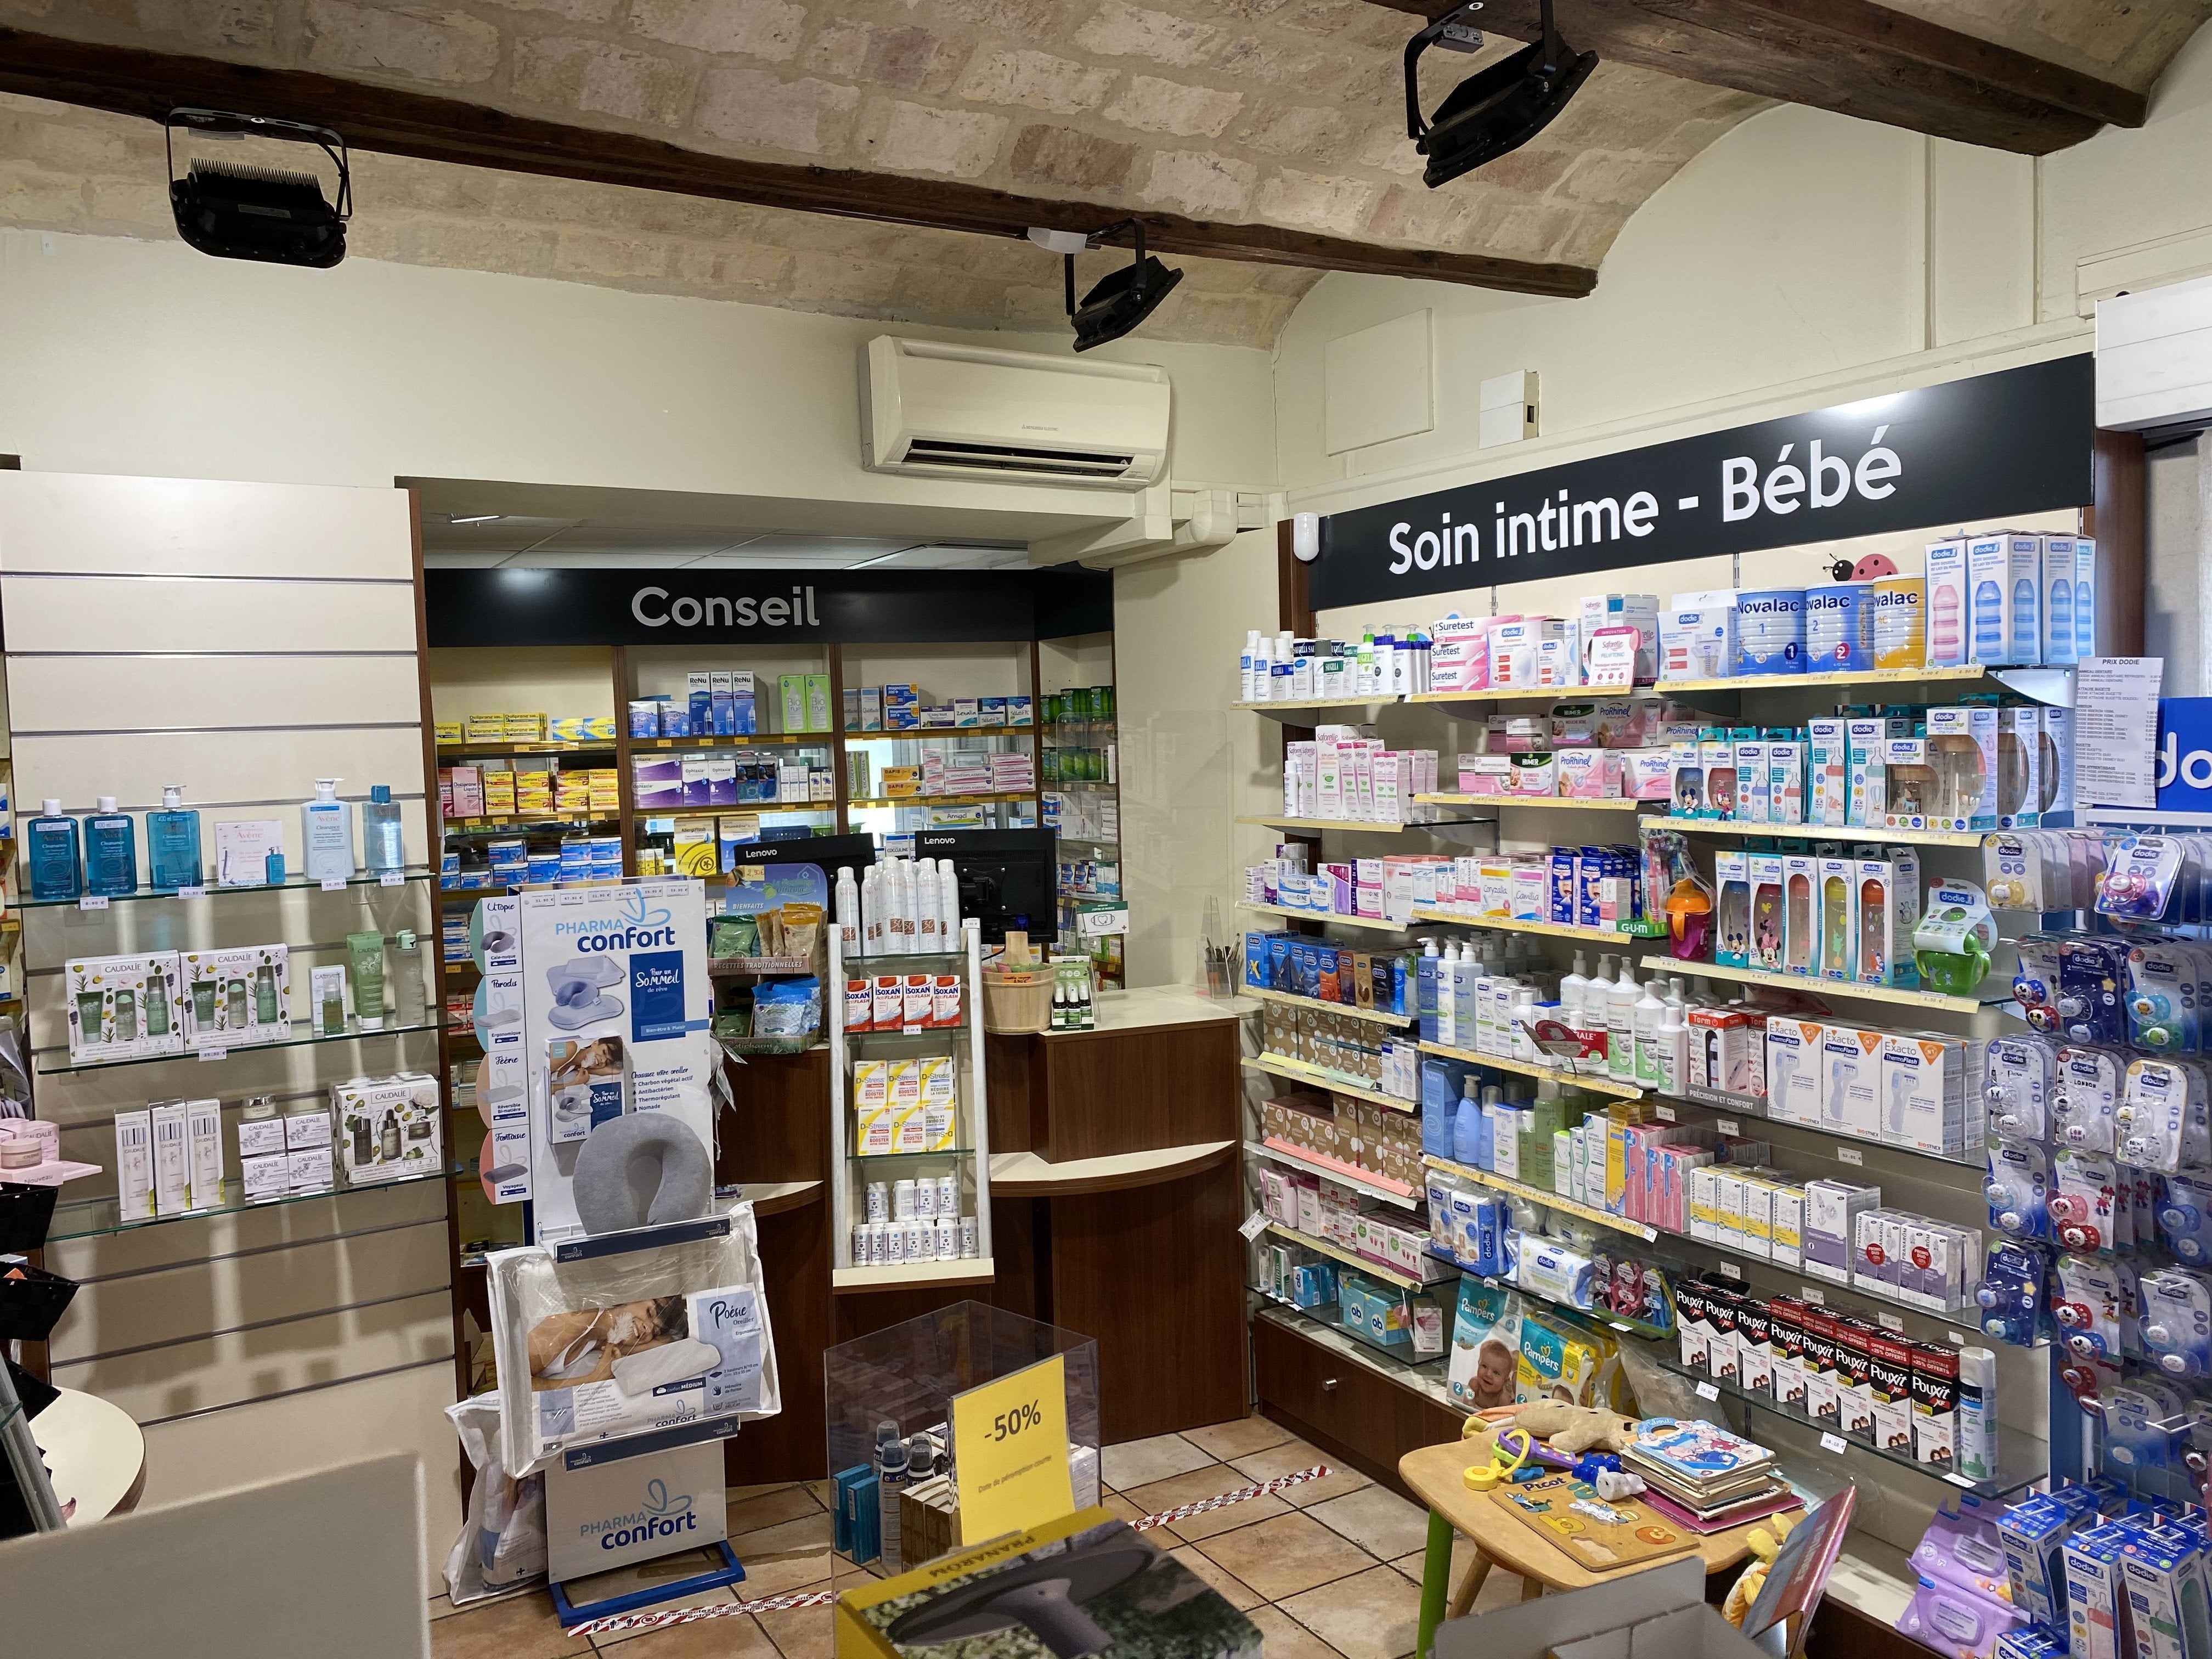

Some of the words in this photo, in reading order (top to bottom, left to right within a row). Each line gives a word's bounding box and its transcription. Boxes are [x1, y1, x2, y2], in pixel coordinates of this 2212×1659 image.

[1389, 519, 1480, 575] Soin
[1496, 491, 1659, 558] intime
[1678, 498, 1699, 508] -
[1723, 426, 1903, 523] Bébé
[631, 585, 820, 627] Conseil
[1737, 598, 1799, 614] Novalac
[1806, 595, 1850, 610] ovalac
[1438, 620, 1475, 631] Suretest
[1432, 646, 1460, 657] Suretest
[1432, 671, 1458, 680] Suretest
[1600, 704, 1631, 716] ProRhinel
[1853, 725, 1873, 733] dodie
[1893, 743, 1911, 751] dodie
[1522, 758, 1539, 766] HUMER
[1561, 755, 1591, 766] ProRhinel
[1640, 759, 1670, 769] ProRhinel
[746, 848, 777, 859] Lenovo
[2000, 847, 2021, 855] dodie
[555, 918, 625, 935] PHARMA
[577, 926, 676, 952] confort
[746, 961, 803, 969] TRADITIONNELLES
[1693, 1015, 1711, 1025] Torm
[1769, 1023, 1797, 1037] Exacto
[1770, 1035, 1799, 1046] ThermoFlash
[1826, 1032, 1855, 1046] Exacto
[1826, 1044, 1857, 1055] ThermoFlash
[1884, 1041, 1917, 1056] Exacto
[1885, 1054, 1918, 1066] ThermoFlash
[638, 1086, 674, 1094] Antibactérien
[639, 1093, 680, 1103] Thermorégulant
[1689, 1088, 1718, 1103] PRÉCISION
[1727, 1098, 1754, 1110] CONFORT
[1857, 1128, 1879, 1137] BIOSYNEX
[1918, 1142, 1941, 1150] BIOSYNEX
[1677, 1290, 1704, 1309] Pouxit
[709, 1300, 747, 1329] Poésie
[1461, 1297, 1496, 1322] Pampers
[1706, 1300, 1735, 1321] Pouxit
[732, 1316, 754, 1325] Oreiller
[1738, 1311, 1768, 1331] Pouxit
[735, 1327, 761, 1336] Ergonomique
[1771, 1323, 1802, 1344] Pouxit
[1803, 1336, 1834, 1358] Pouxit
[1523, 1341, 1560, 1372] Pampers
[1836, 1348, 1868, 1372] Pouxit
[1871, 1364, 1907, 1387] Pouxit
[681, 1379, 703, 1390] MÉDIUM
[1912, 1376, 1950, 1399] Pouxit
[656, 1414, 697, 1427] confort
[984, 1399, 1041, 1442] -50%
[1522, 1476, 1567, 1492] Picot
[580, 1511, 647, 1536] PHARMA
[601, 1511, 697, 1550] confort
